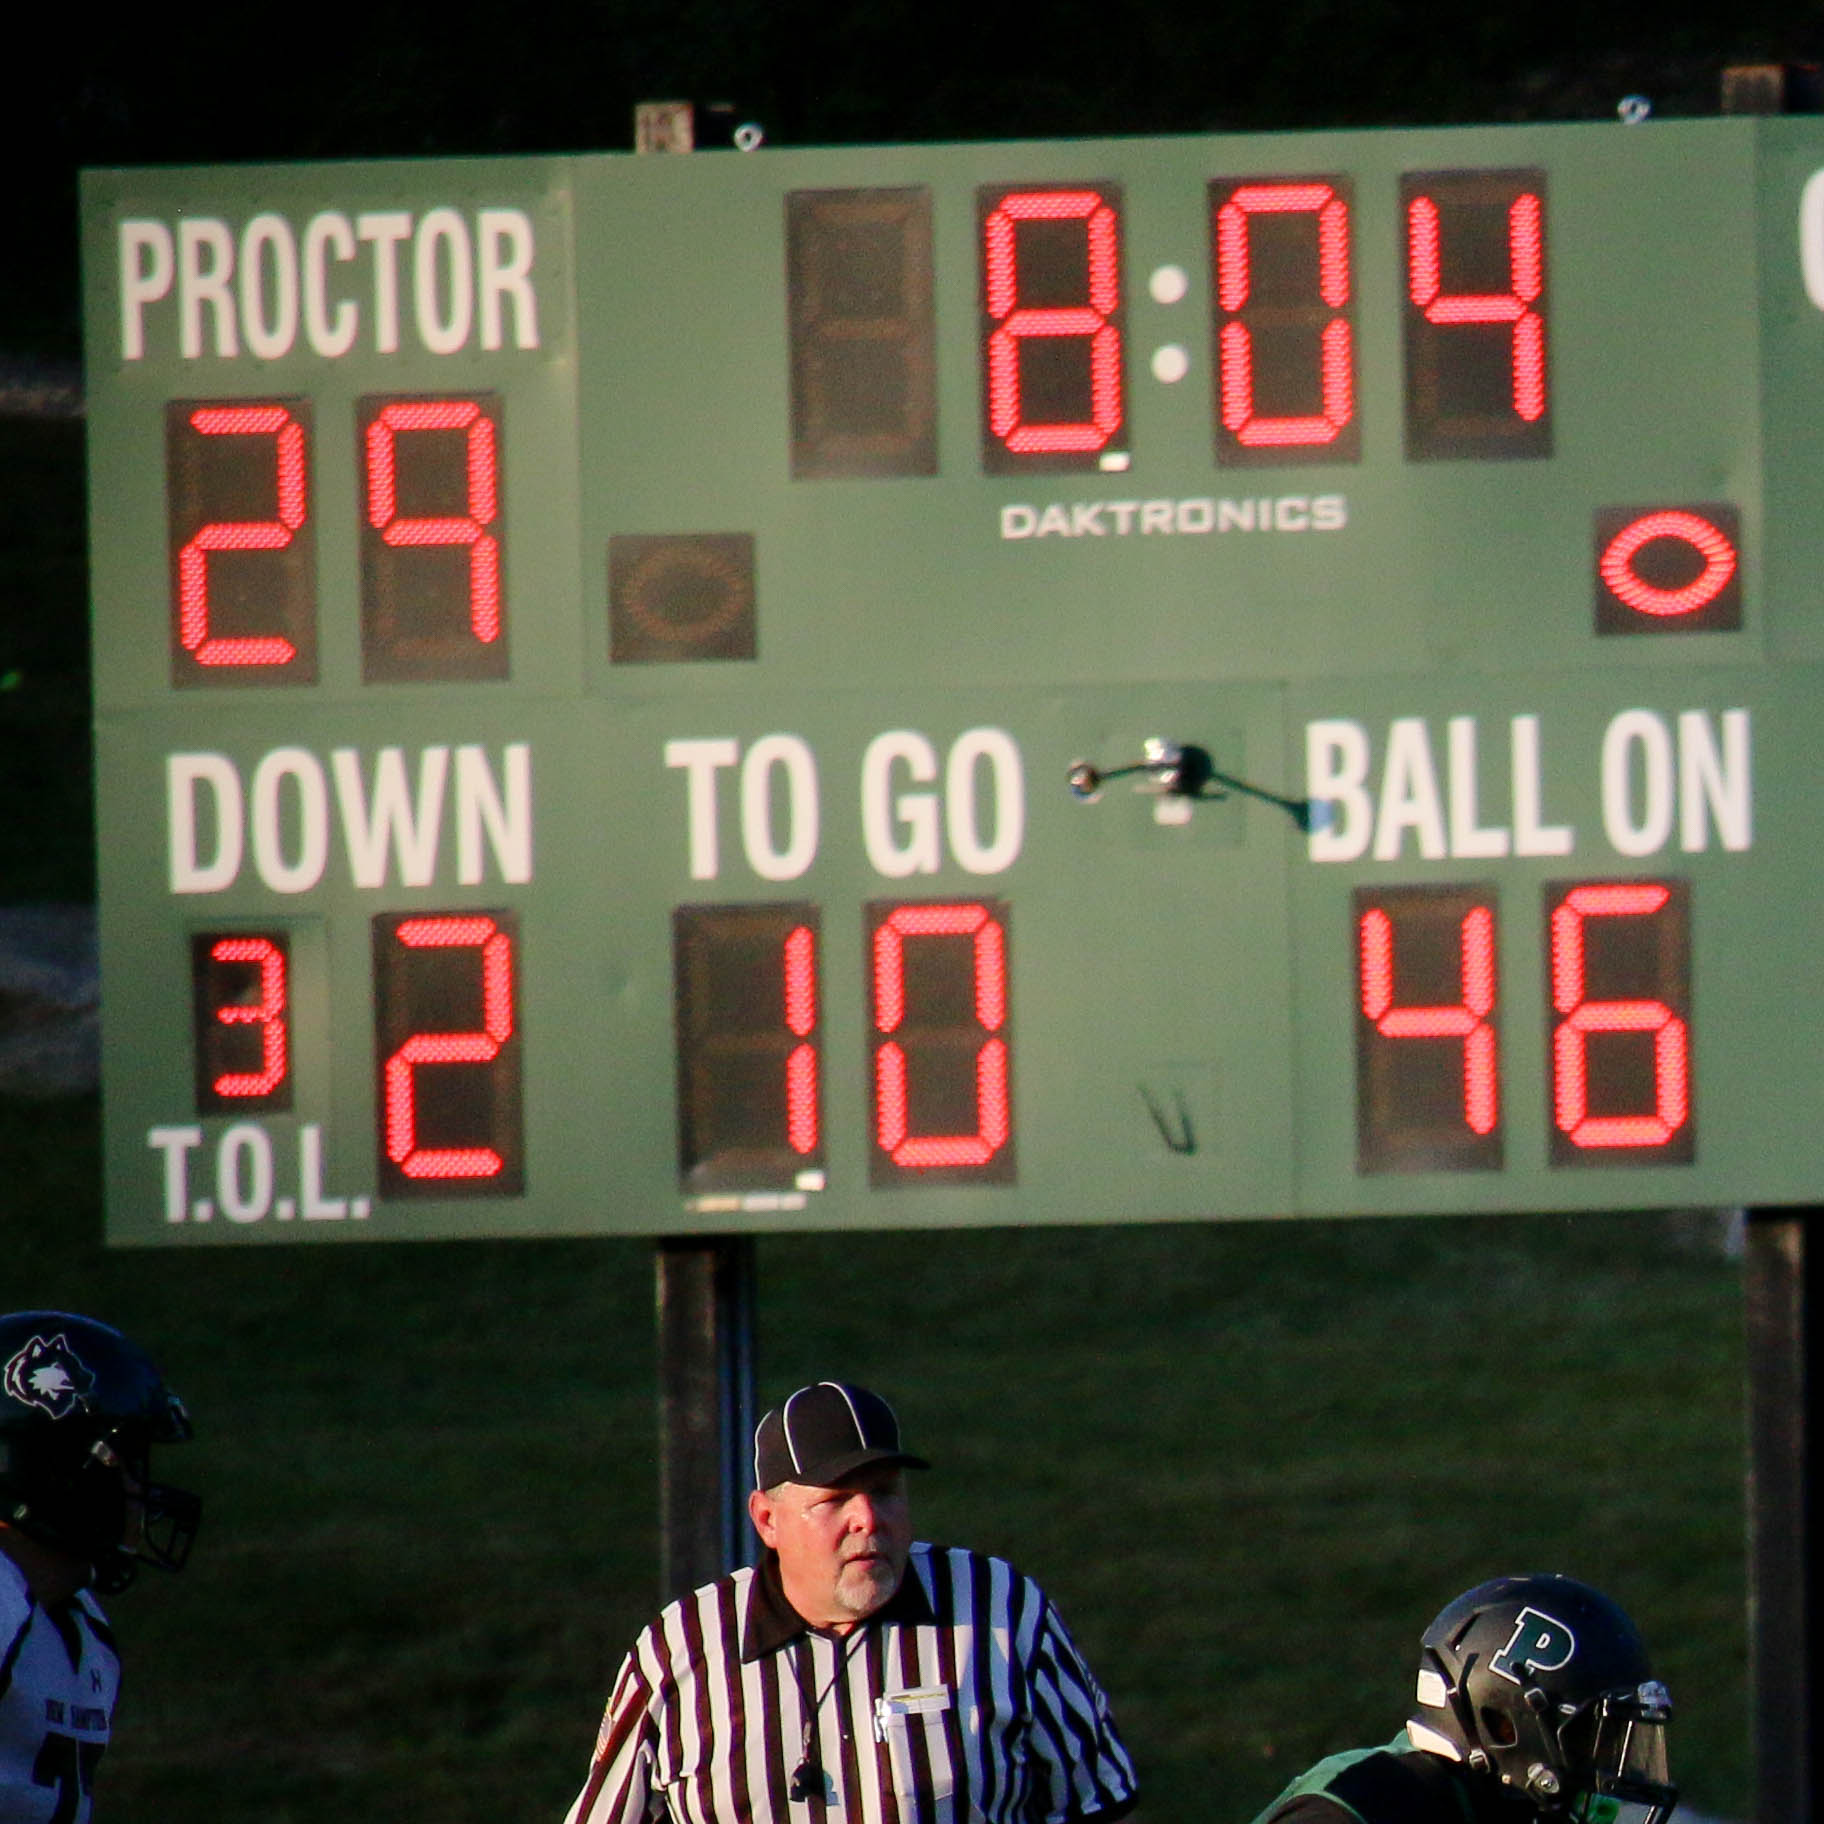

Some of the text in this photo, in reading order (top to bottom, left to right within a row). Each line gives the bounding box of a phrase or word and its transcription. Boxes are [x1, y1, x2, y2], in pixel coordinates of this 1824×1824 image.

[118, 207, 541, 361] PROCTOR
[985, 184, 1547, 453] 8:04
[180, 400, 501, 665] 29
[1001, 495, 1348, 541] DAKTRONICS
[166, 742, 532, 894] DOWN
[664, 726, 1025, 881] TO GO
[1305, 708, 1752, 863] BALL ON
[211, 938, 286, 1097] 3
[385, 916, 513, 1178] 2
[784, 904, 1009, 1166] 10
[1360, 884, 1689, 1149] 46
[148, 1121, 371, 1224] T.O.L.
